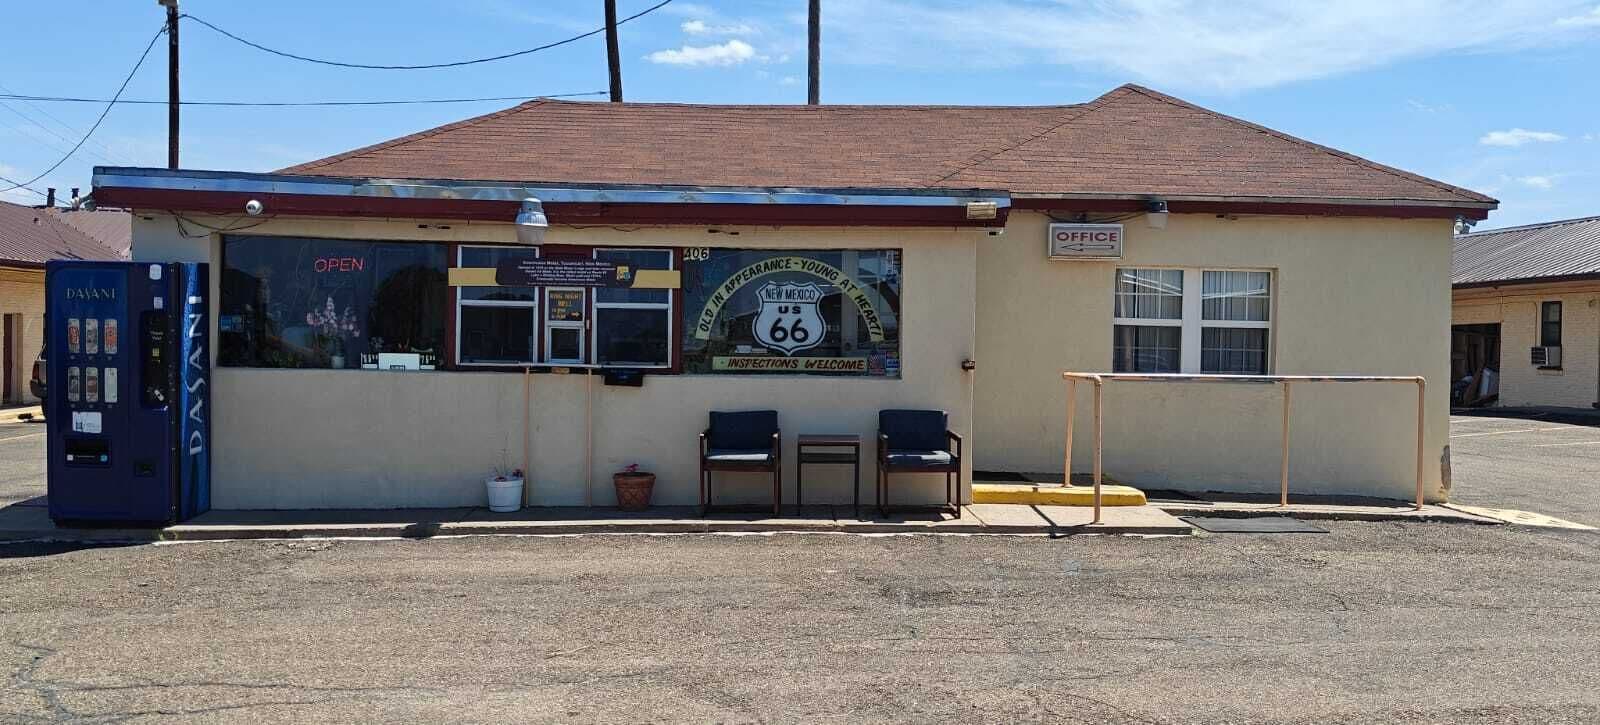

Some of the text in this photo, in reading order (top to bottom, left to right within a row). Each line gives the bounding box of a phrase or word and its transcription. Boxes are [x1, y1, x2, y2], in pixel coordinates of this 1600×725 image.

[1056, 231, 1118, 242] OFFICE
[684, 248, 708, 259] 406
[315, 257, 364, 273] OPEN
[66, 287, 116, 300] DASANI
[700, 308, 714, 332] OLD
[711, 293, 724, 308] IN
[724, 258, 792, 294] APPEARANCE
[801, 259, 839, 281] YOUNG
[840, 279, 858, 293] AT
[765, 288, 816, 300] NEW MEXICO
[770, 317, 809, 343] 66
[727, 358, 865, 370] INSPECTIONS WELCOME
[188, 296, 206, 456] DASANI
